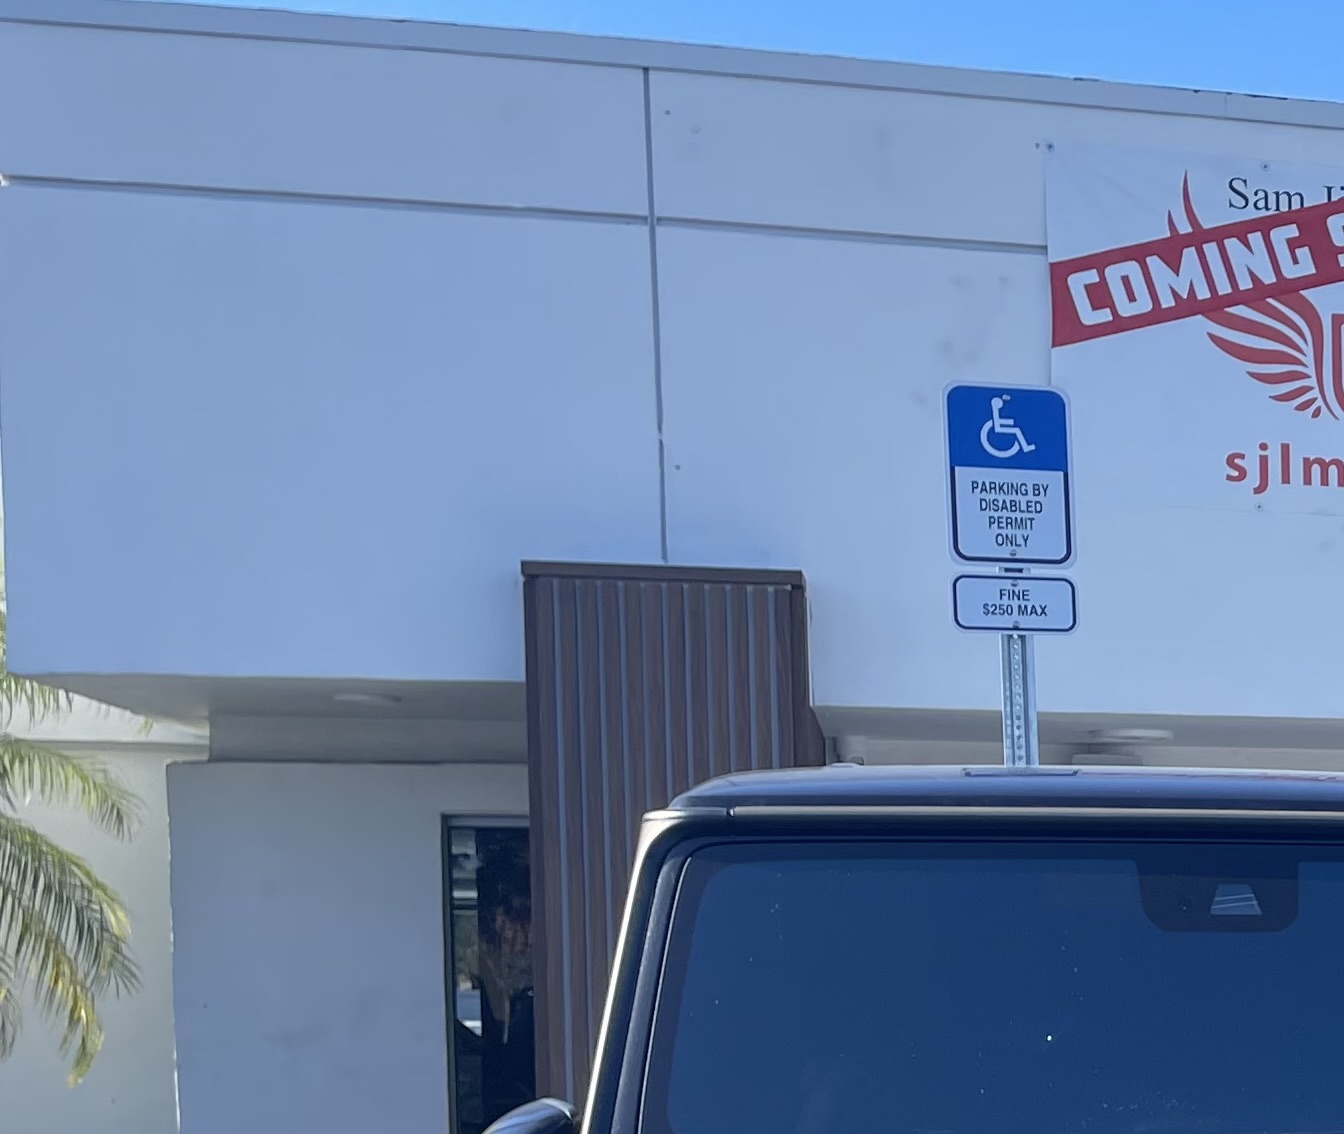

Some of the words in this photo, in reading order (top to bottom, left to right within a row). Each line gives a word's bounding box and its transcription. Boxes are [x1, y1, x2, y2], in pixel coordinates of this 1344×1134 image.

[1228, 177, 1305, 212] Sam
[1065, 223, 1318, 328] COMING
[970, 480, 1029, 497] PARKING
[1032, 483, 1049, 498] BY
[979, 498, 1043, 514] DISABLED
[987, 515, 1036, 531] PERMIT
[995, 533, 1030, 548] ONLY
[998, 588, 1031, 602] FINE
[982, 603, 1014, 617] $250
[1017, 603, 1048, 617] MAX
